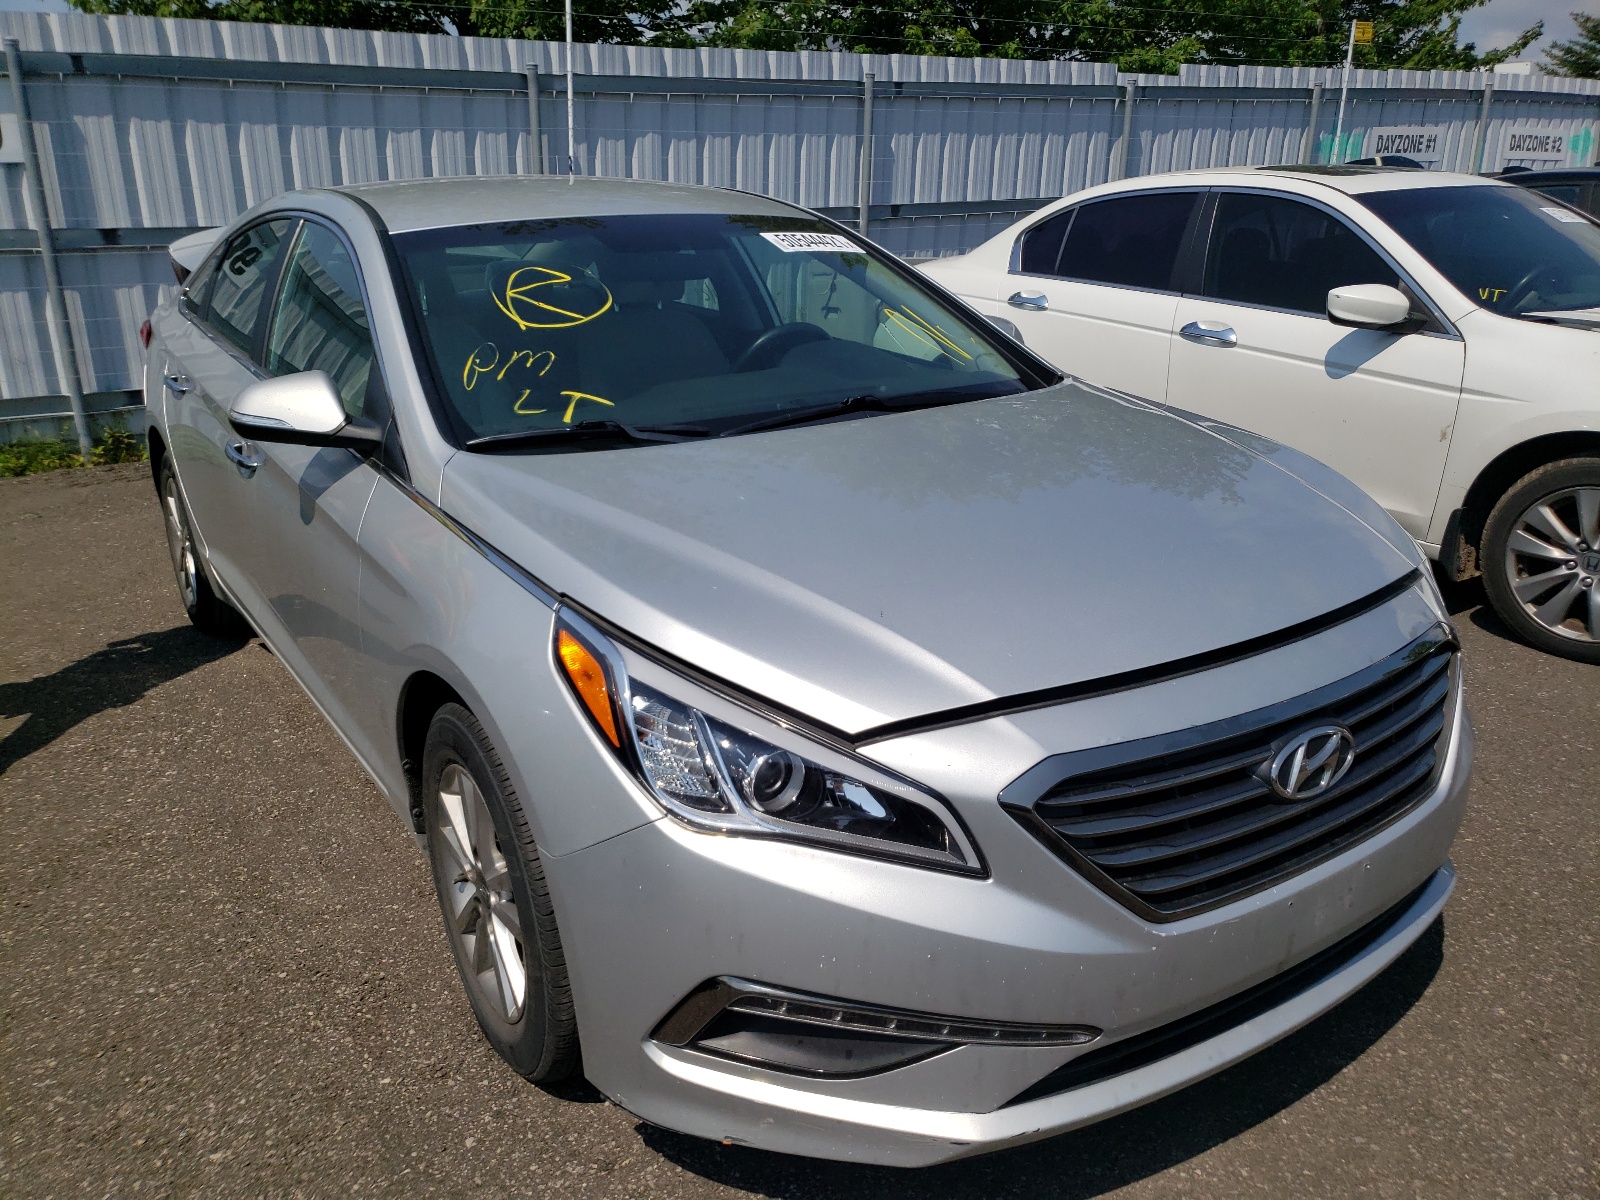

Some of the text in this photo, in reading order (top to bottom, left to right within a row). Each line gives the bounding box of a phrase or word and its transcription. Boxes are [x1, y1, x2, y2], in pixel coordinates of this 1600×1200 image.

[1376, 134, 1438, 153] DAYZONE #1
[1509, 134, 1563, 153] DAYZONE #2
[774, 233, 849, 248] 50544421
[1479, 288, 1508, 302] VT
